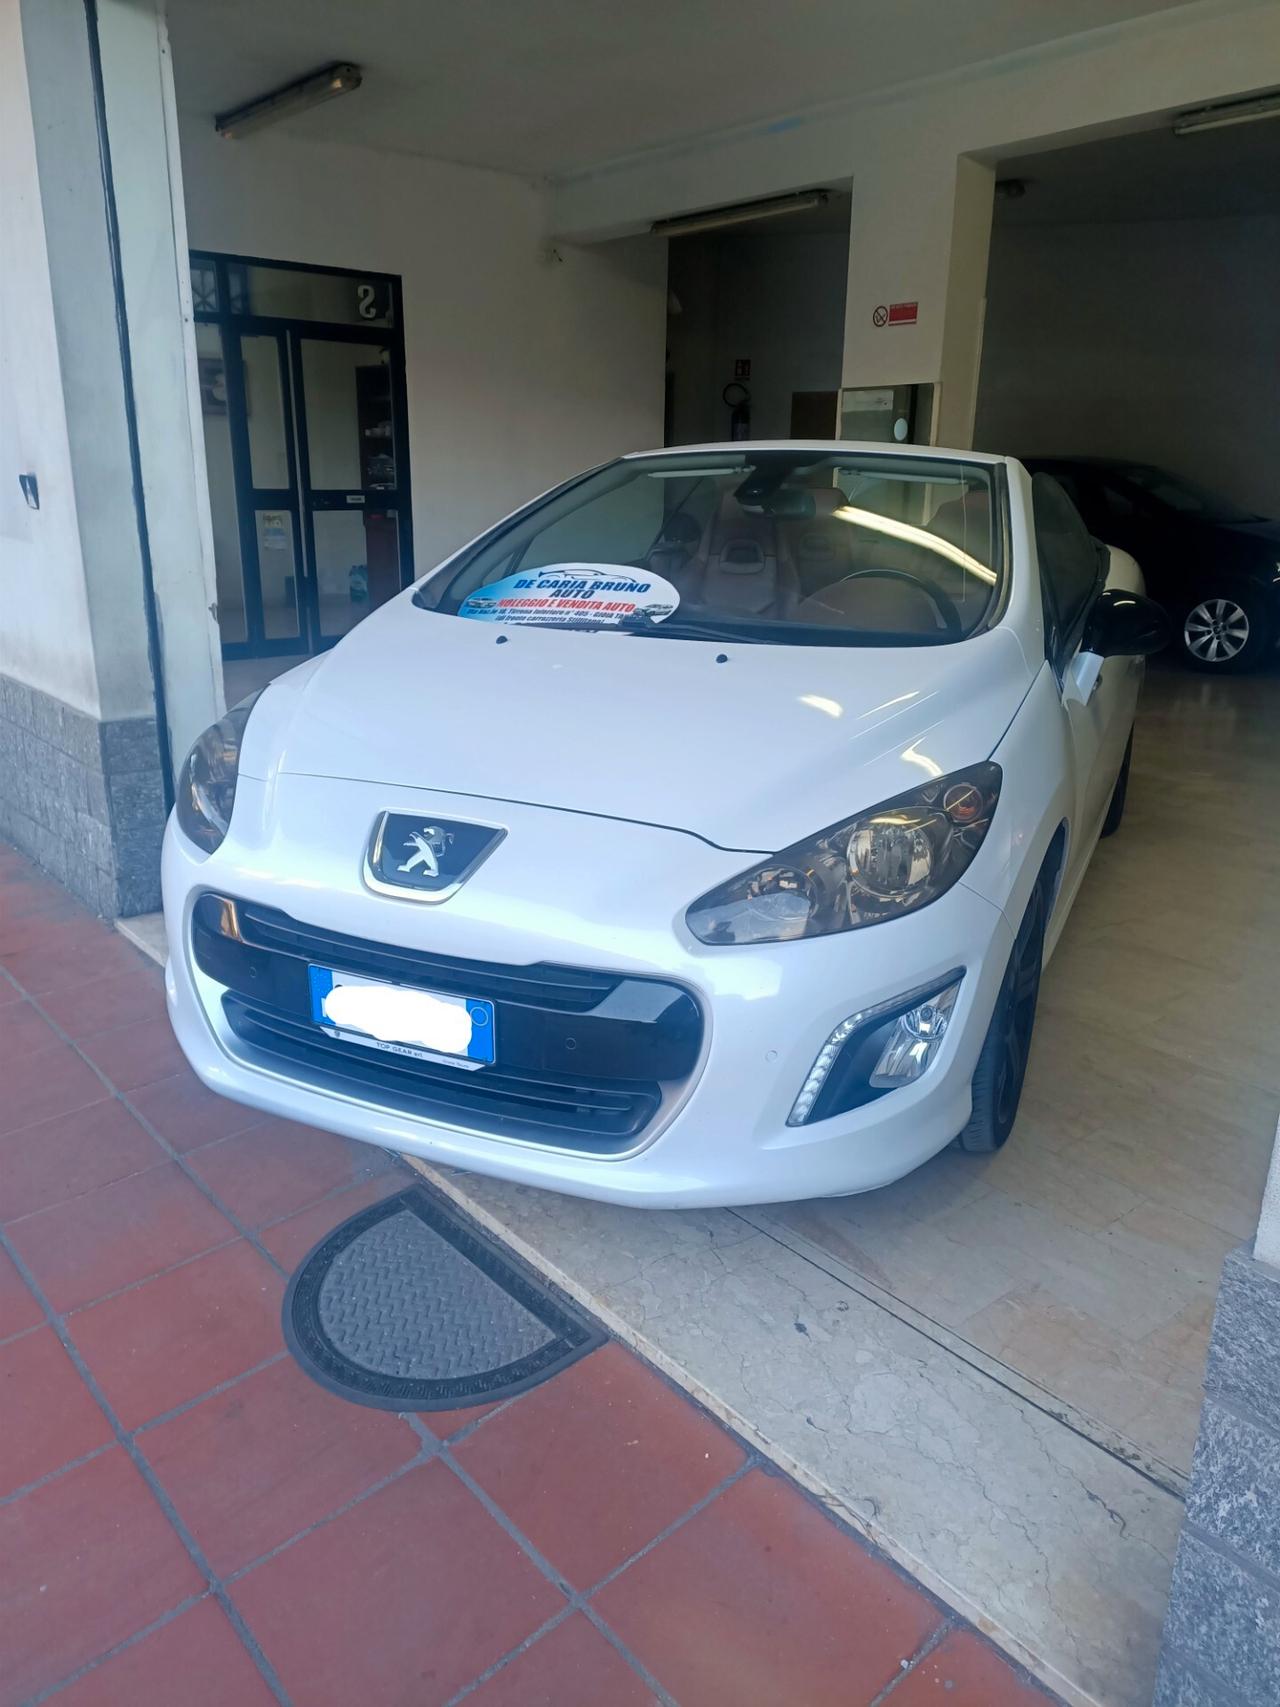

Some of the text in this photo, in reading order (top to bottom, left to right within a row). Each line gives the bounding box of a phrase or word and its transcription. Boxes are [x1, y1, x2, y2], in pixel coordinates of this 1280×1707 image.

[513, 579, 651, 593] DE CARIA BRUNO
[549, 589, 596, 599] AUTO
[497, 598, 636, 613] NOLEGGIO E VENDITA AUTO
[376, 1041, 391, 1049] TOP
[392, 1046, 413, 1055] GEAR
